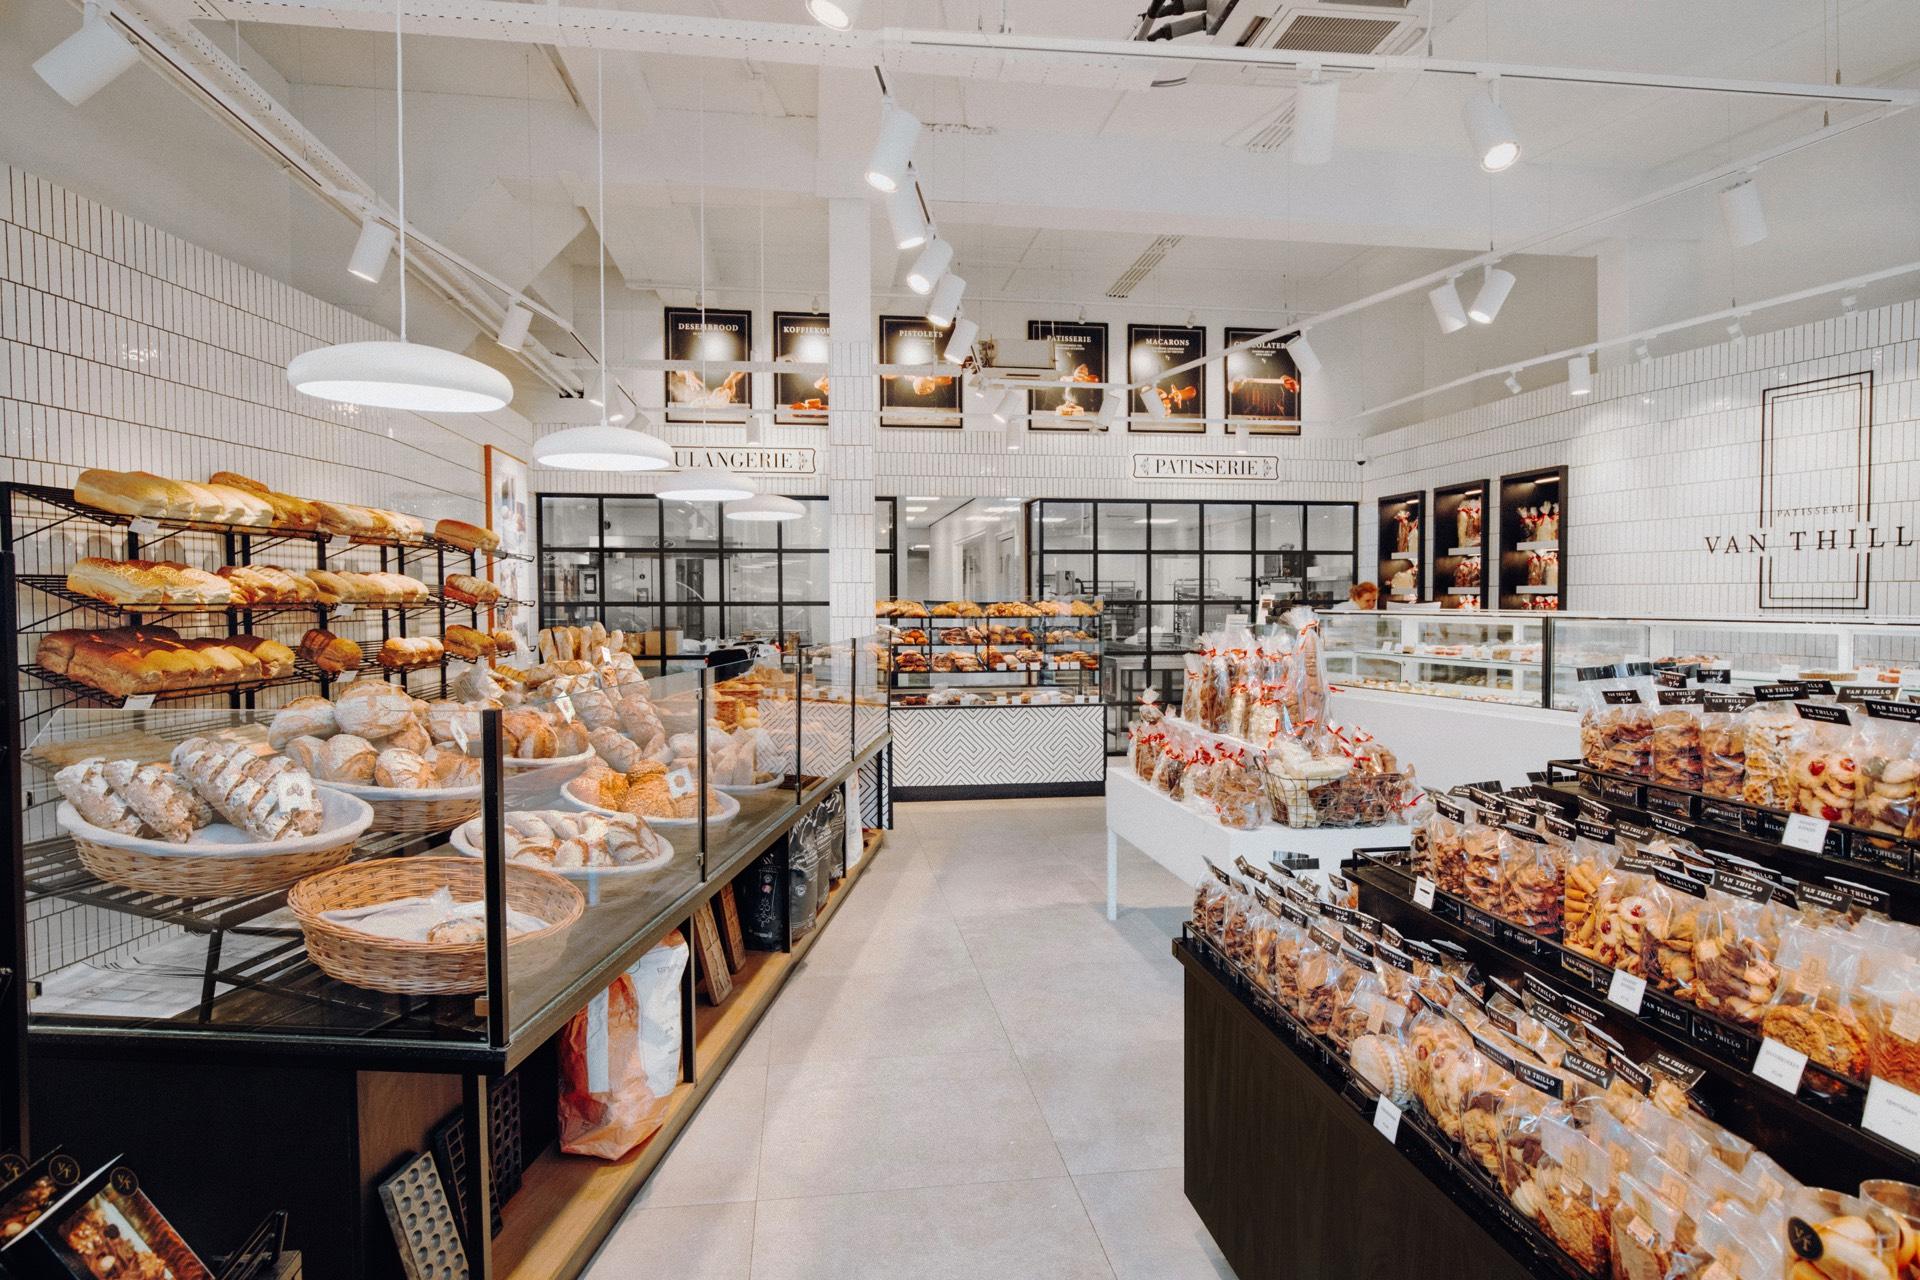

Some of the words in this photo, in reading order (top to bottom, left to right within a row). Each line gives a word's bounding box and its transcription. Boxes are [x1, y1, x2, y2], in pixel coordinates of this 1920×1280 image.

[899, 330, 943, 338] PISTOLETS
[1047, 335, 1092, 343] PATISSERIE
[1145, 338, 1190, 346] MACARONS
[674, 451, 793, 469] ULANGERIE
[1156, 459, 1258, 475] PATISSERIE
[1777, 505, 1854, 517] PATISSERIE
[1704, 533, 1768, 554] VAN
[1789, 526, 1913, 550] THILL
[1815, 709, 1839, 717] THILLO
[1888, 706, 1917, 714] THILLO
[1651, 816, 1663, 825] VAN
[1664, 821, 1686, 832] THILLO
[1876, 850, 1903, 861] THILLO
[1659, 872, 1673, 880] VAN
[1674, 878, 1698, 890] THILLO
[1719, 875, 1734, 884] VAN
[1736, 880, 1763, 893] THILLO
[1802, 885, 1816, 894] VAN
[1818, 889, 1843, 902] THILLO
[1834, 884, 1848, 893] VAN
[1850, 889, 1880, 902] THILLO
[1527, 980, 1537, 988] VAN
[1538, 986, 1556, 1001] THILLO
[1537, 1006, 1548, 1015] VAN
[1549, 1012, 1569, 1027] THILLO
[1567, 1002, 1577, 1010] VAN
[1578, 1007, 1598, 1021] THILLO
[1643, 1001, 1656, 1010] VAN
[1657, 1006, 1681, 1021] THILLO
[1700, 1027, 1713, 1036] VAN
[1715, 1034, 1741, 1049] THILLO
[1569, 1055, 1582, 1065] VAN
[1582, 1060, 1606, 1076] THILLO
[1658, 1053, 1669, 1063] VAN
[1671, 1059, 1694, 1074] THILLO
[1520, 1066, 1532, 1076] VAN
[1533, 1071, 1555, 1087] THILLO
[1622, 1064, 1644, 1083] THILLO
